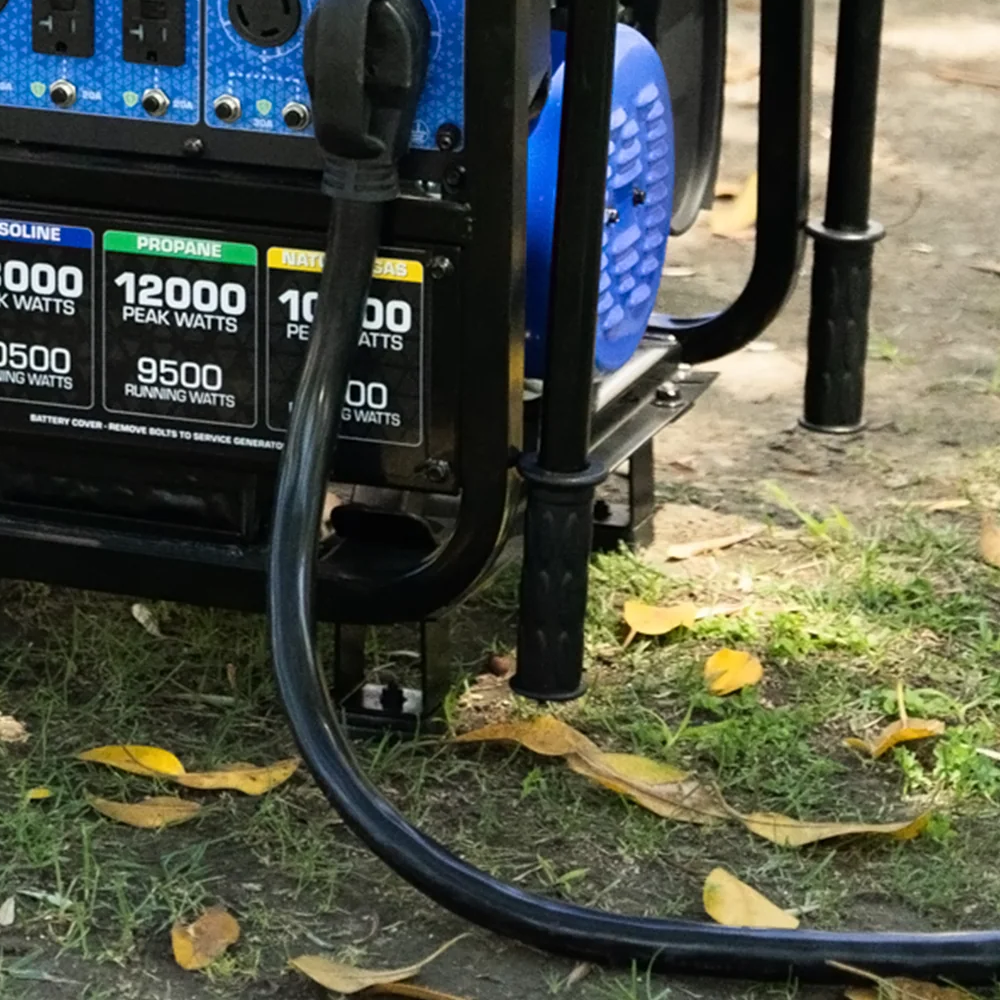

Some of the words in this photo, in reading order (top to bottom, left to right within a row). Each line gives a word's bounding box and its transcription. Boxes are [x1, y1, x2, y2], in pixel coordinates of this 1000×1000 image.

[136, 236, 222, 258] PROPANE
[12, 296, 75, 316] WATTS
[114, 272, 246, 316] 12000
[122, 306, 170, 326] PEAK
[173, 313, 238, 333] WATTS
[278, 289, 412, 333] 1000
[286, 324, 309, 340] PE
[357, 331, 403, 351] ATTS
[27, 373, 73, 390] WATTS
[137, 357, 222, 391] 9500
[124, 383, 187, 403] RUNNING
[189, 390, 236, 408] WATTS
[30, 413, 70, 426] BATTERY
[72, 416, 102, 430] COVER
[109, 422, 147, 435] REMOVE
[149, 426, 177, 439] BOLTS
[179, 429, 191, 440] TO
[193, 432, 232, 446] SERVICE
[233, 436, 284, 450] GENERATO
[353, 410, 401, 427] WATTS
